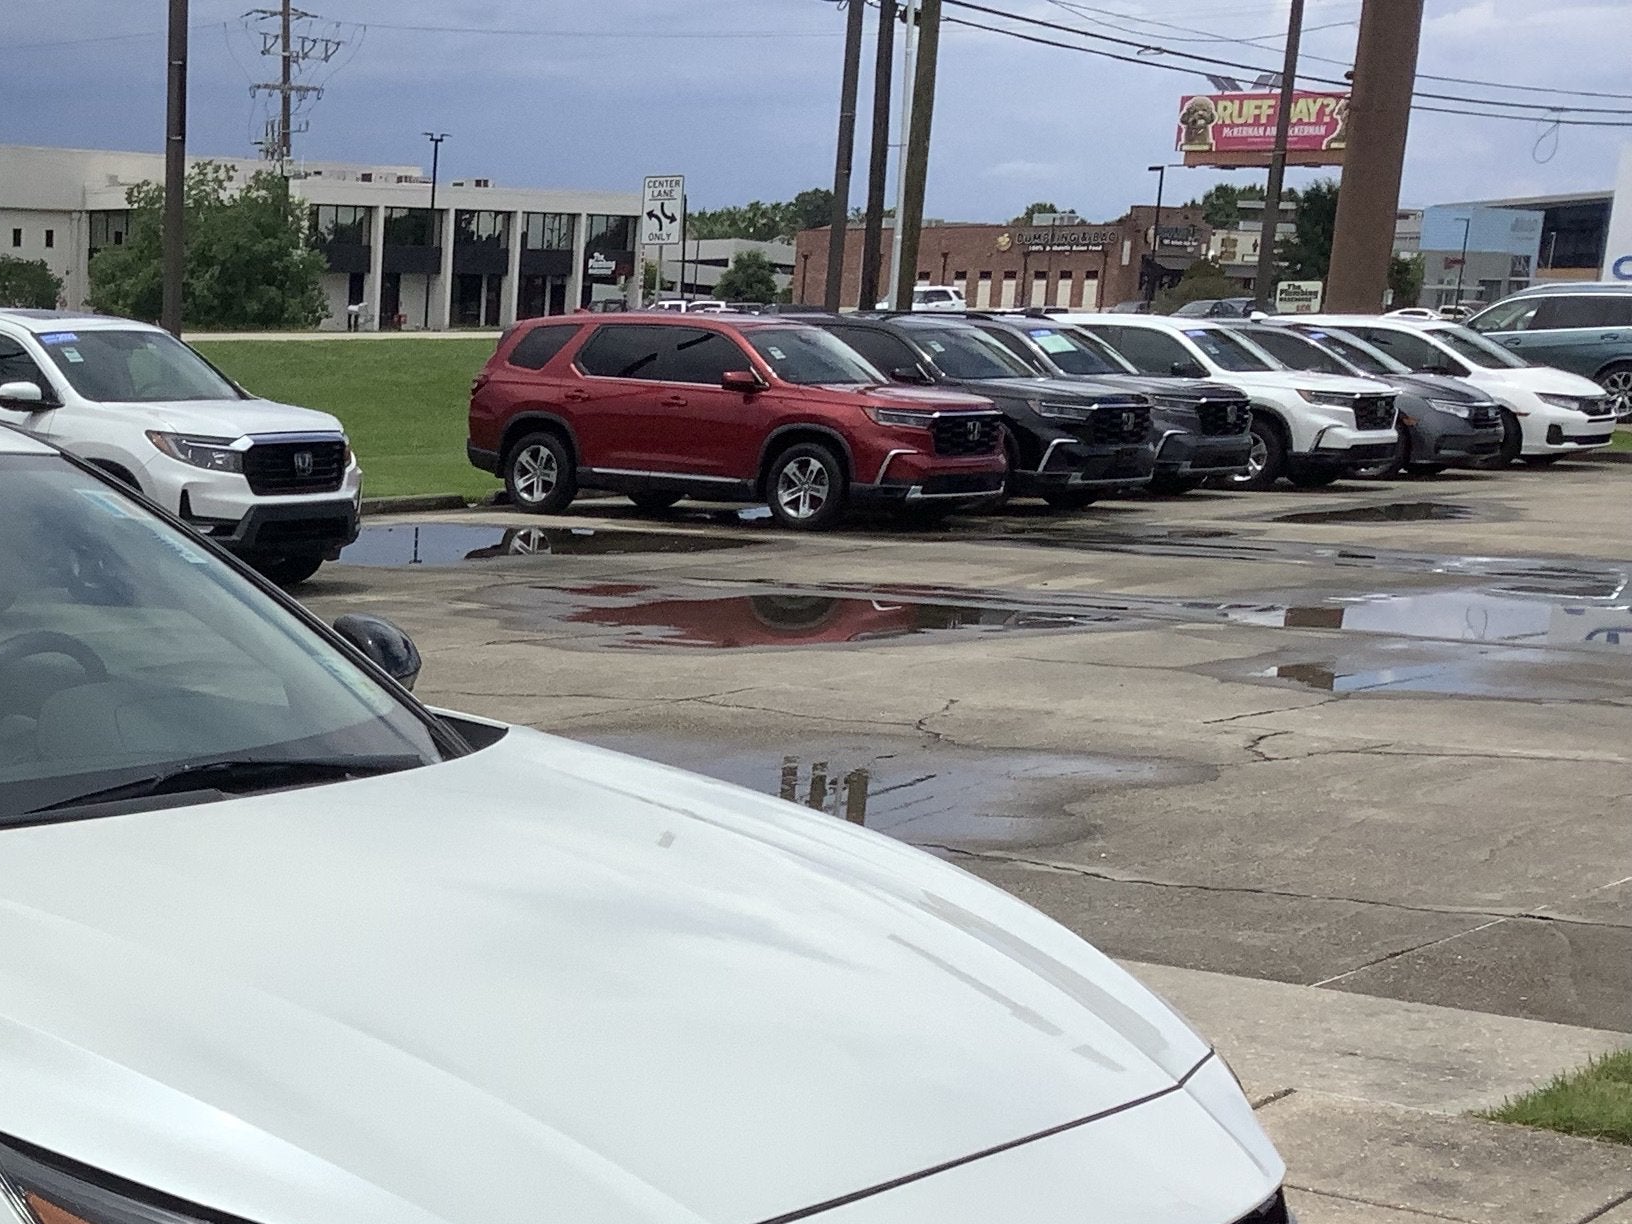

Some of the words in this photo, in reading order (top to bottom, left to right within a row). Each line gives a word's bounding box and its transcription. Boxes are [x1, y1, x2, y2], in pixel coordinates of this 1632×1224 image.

[1217, 100, 1275, 124] RUFF
[1290, 98, 1336, 123] AY?
[1265, 127, 1277, 137] AN
[1287, 126, 1326, 136] cKERNAN
[647, 180, 680, 189] CENTER
[651, 190, 675, 198] LANE
[648, 233, 672, 241] ONLY
[1016, 232, 1079, 244] DUMPING
